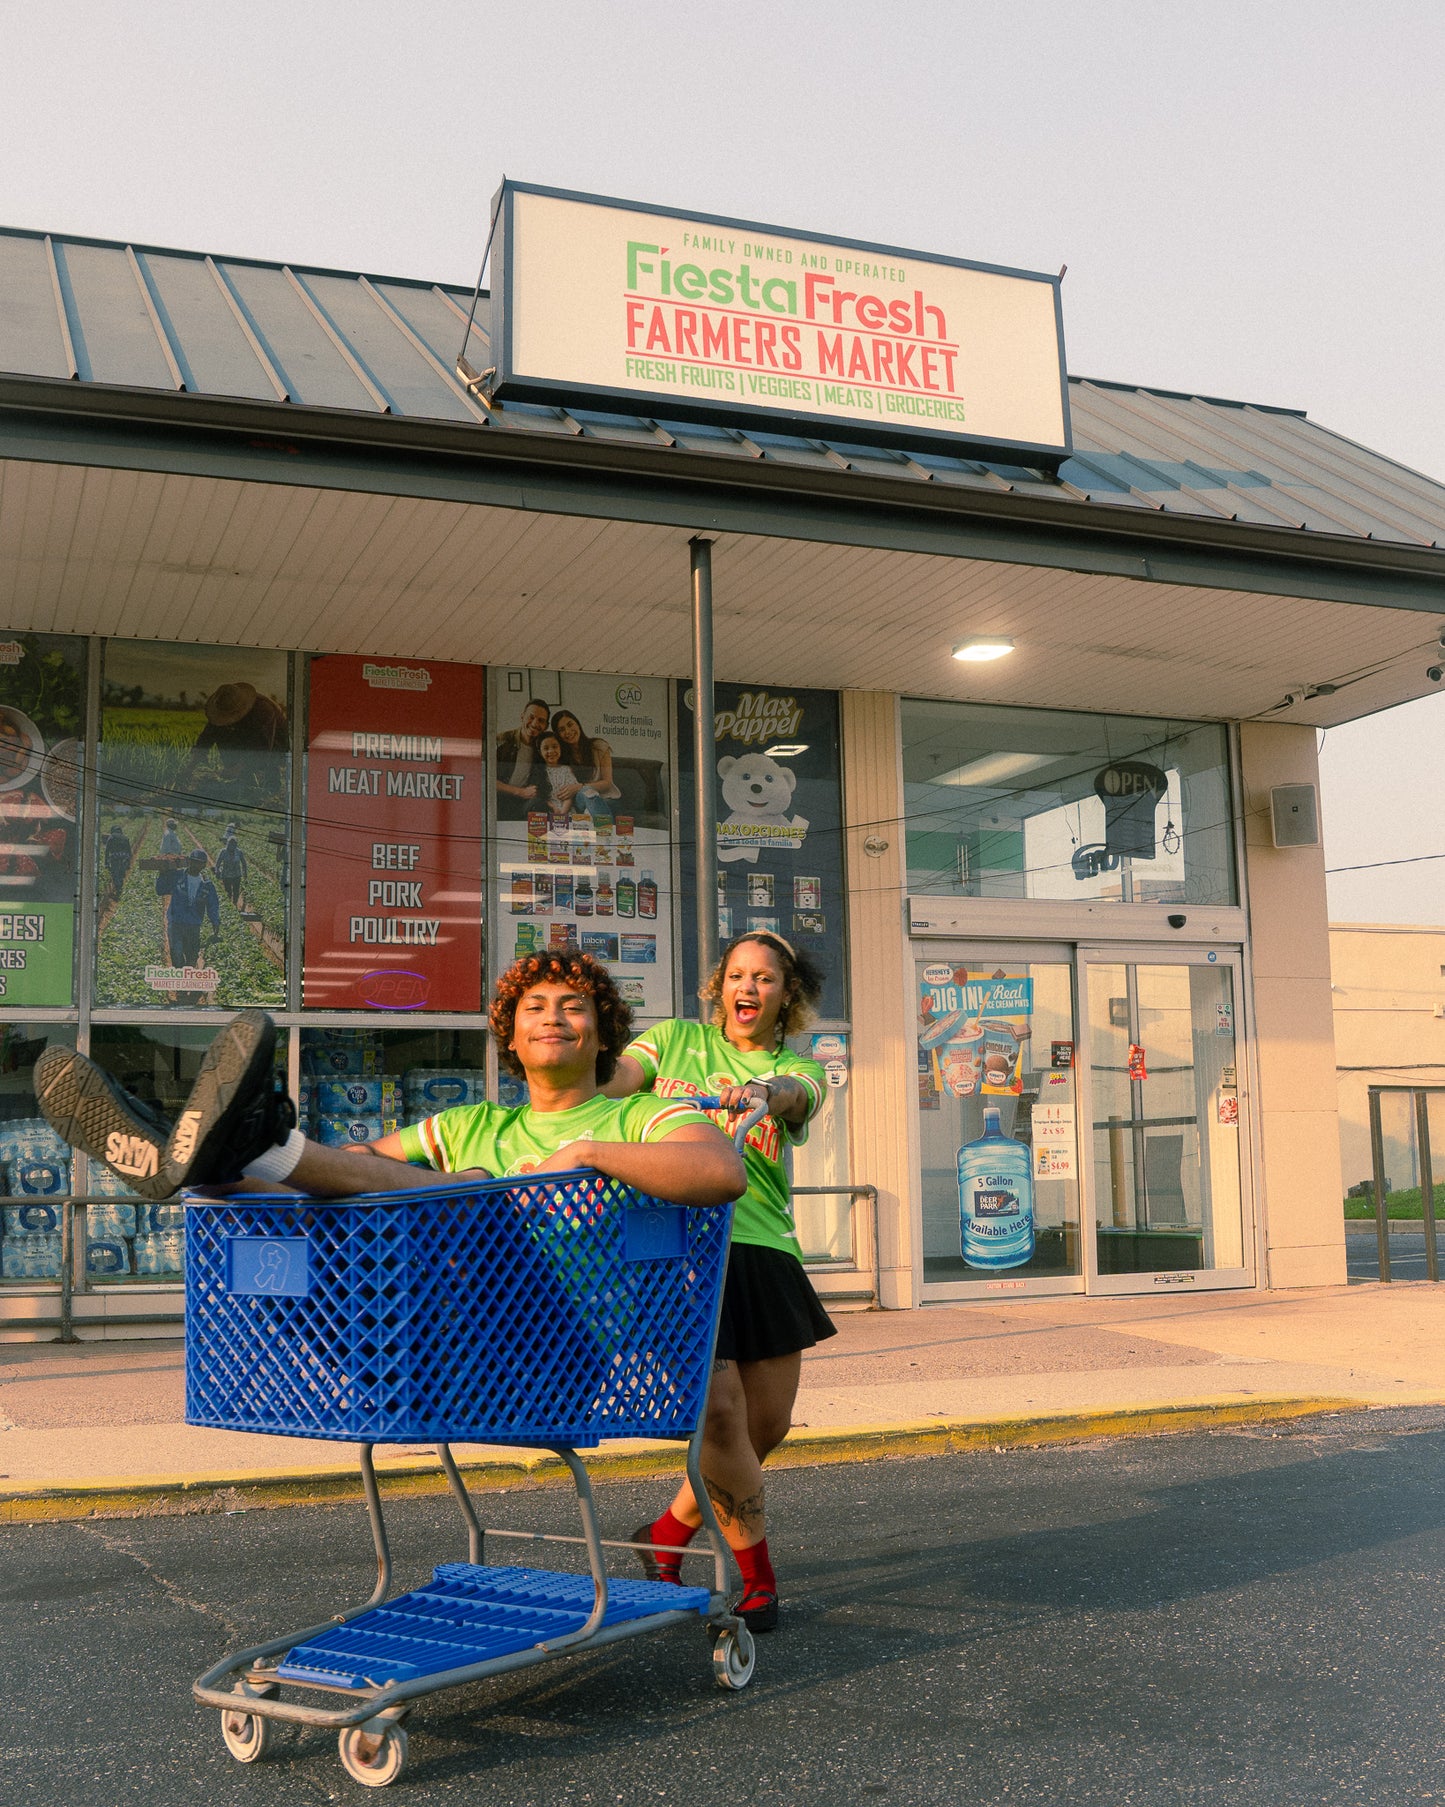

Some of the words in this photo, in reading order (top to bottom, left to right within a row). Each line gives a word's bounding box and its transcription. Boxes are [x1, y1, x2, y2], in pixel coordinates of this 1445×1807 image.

[684, 233, 735, 254] FAMILY
[744, 243, 792, 264] OWNED
[801, 253, 827, 270] AND
[836, 259, 905, 283] OPERATED
[627, 301, 802, 371] FARMERS
[817, 330, 958, 392] MARKET
[626, 358, 677, 383] FRESH
[681, 365, 735, 391] FRUITS
[748, 374, 812, 401] VEGGIES
[824, 384, 874, 409] MEATS
[886, 393, 966, 422] GROCERIES
[618, 689, 642, 701] CAD
[736, 692, 795, 718] Max
[594, 724, 600, 734] al
[602, 725, 628, 736] cuidado
[630, 727, 638, 736] de
[640, 727, 646, 737] la
[647, 729, 661, 739] tuya
[603, 714, 629, 724] Nuestra
[714, 709, 801, 742] Pappel
[352, 732, 442, 762] PREMIUM
[329, 768, 382, 795] MEAT
[387, 771, 464, 800] MARKET
[1104, 769, 1158, 798] OPEN
[740, 824, 806, 838] OPCIONES
[372, 843, 420, 870] BEEF
[368, 880, 423, 908] PORK
[350, 916, 440, 945] POULTRY
[358, 979, 431, 999] OPEN
[930, 986, 957, 1012] DIG
[993, 984, 1024, 999] Real
[987, 1001, 995, 1009] ICE
[996, 1000, 1014, 1009] CREAM
[1015, 999, 1029, 1008] PINTS
[105, 1132, 158, 1177] VANS
[978, 1178, 984, 1187] 5
[986, 1176, 1013, 1186] Gallon
[965, 1219, 1008, 1236] Available
[1009, 1215, 1031, 1232] Here
